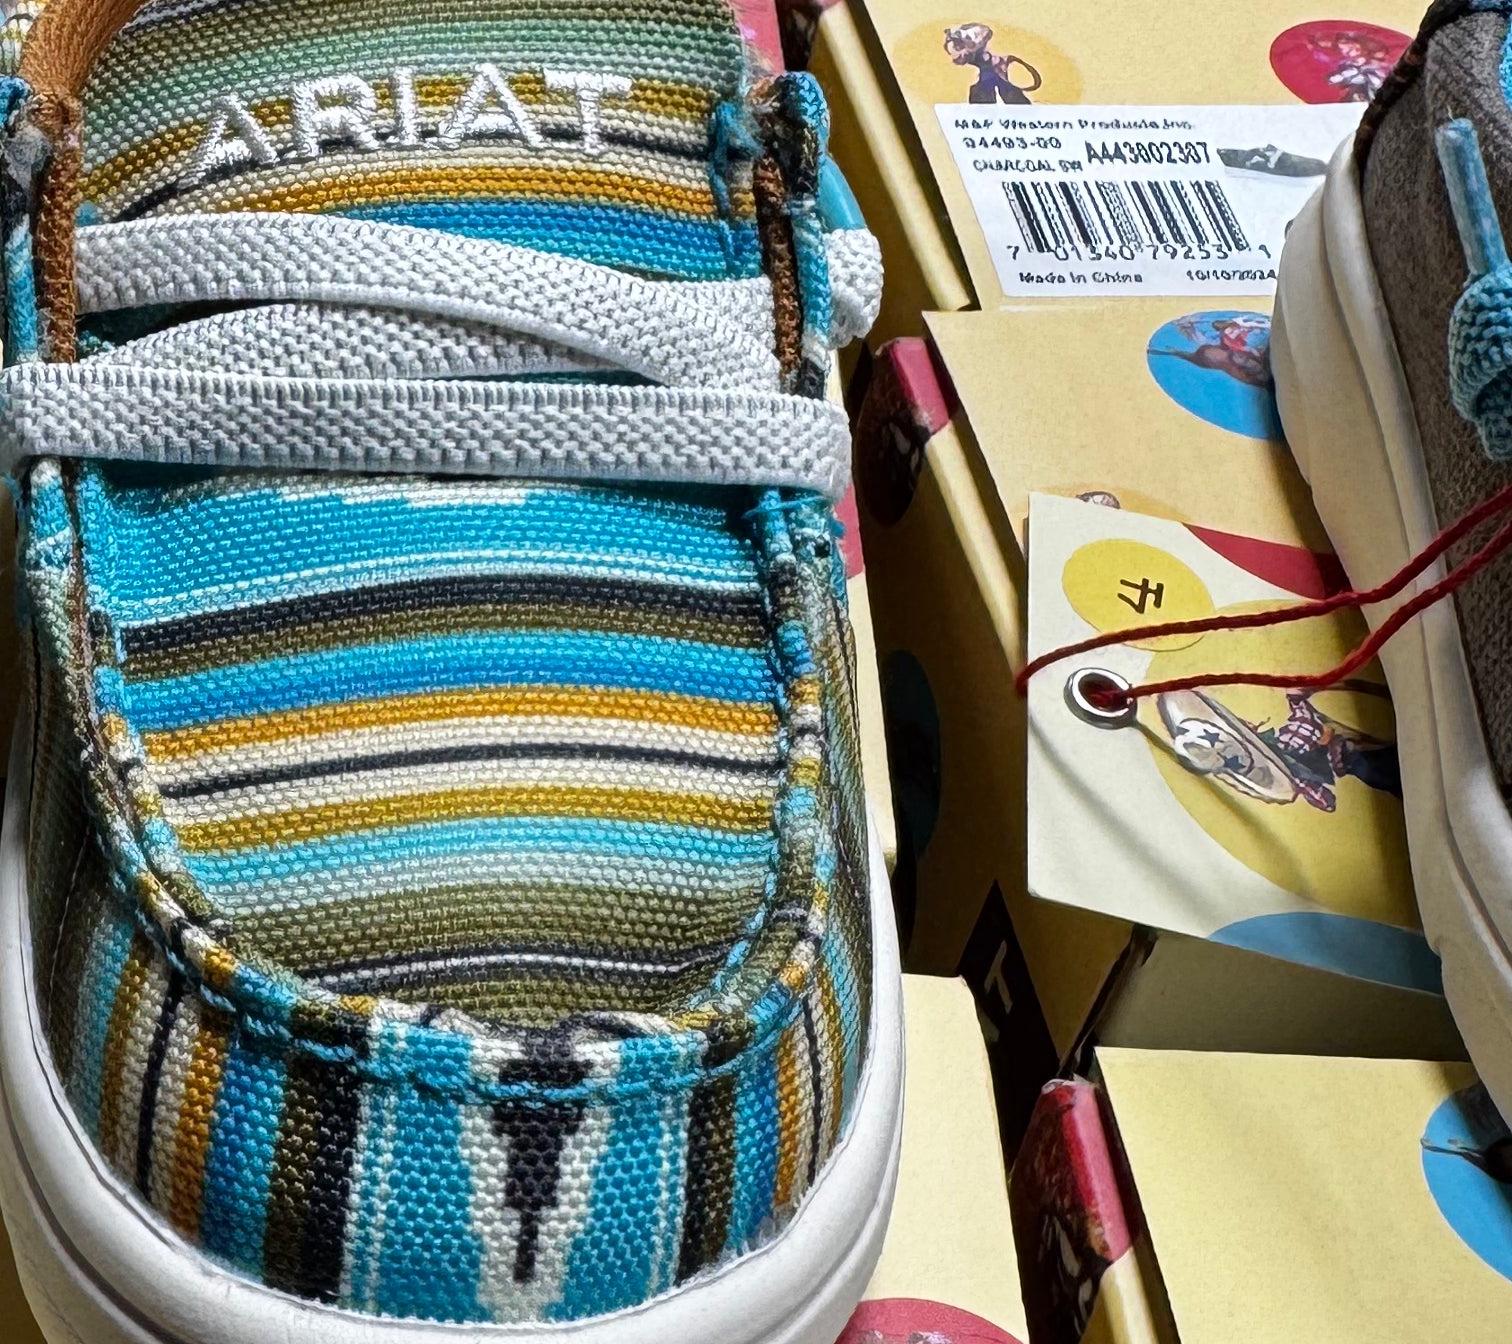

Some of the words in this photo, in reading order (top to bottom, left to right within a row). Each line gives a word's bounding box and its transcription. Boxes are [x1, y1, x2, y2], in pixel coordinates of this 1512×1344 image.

[191, 62, 634, 174] ARIAT
[1085, 141, 1211, 166] A443002307
[1006, 245, 1021, 260] 7
[1116, 577, 1165, 615] 4
